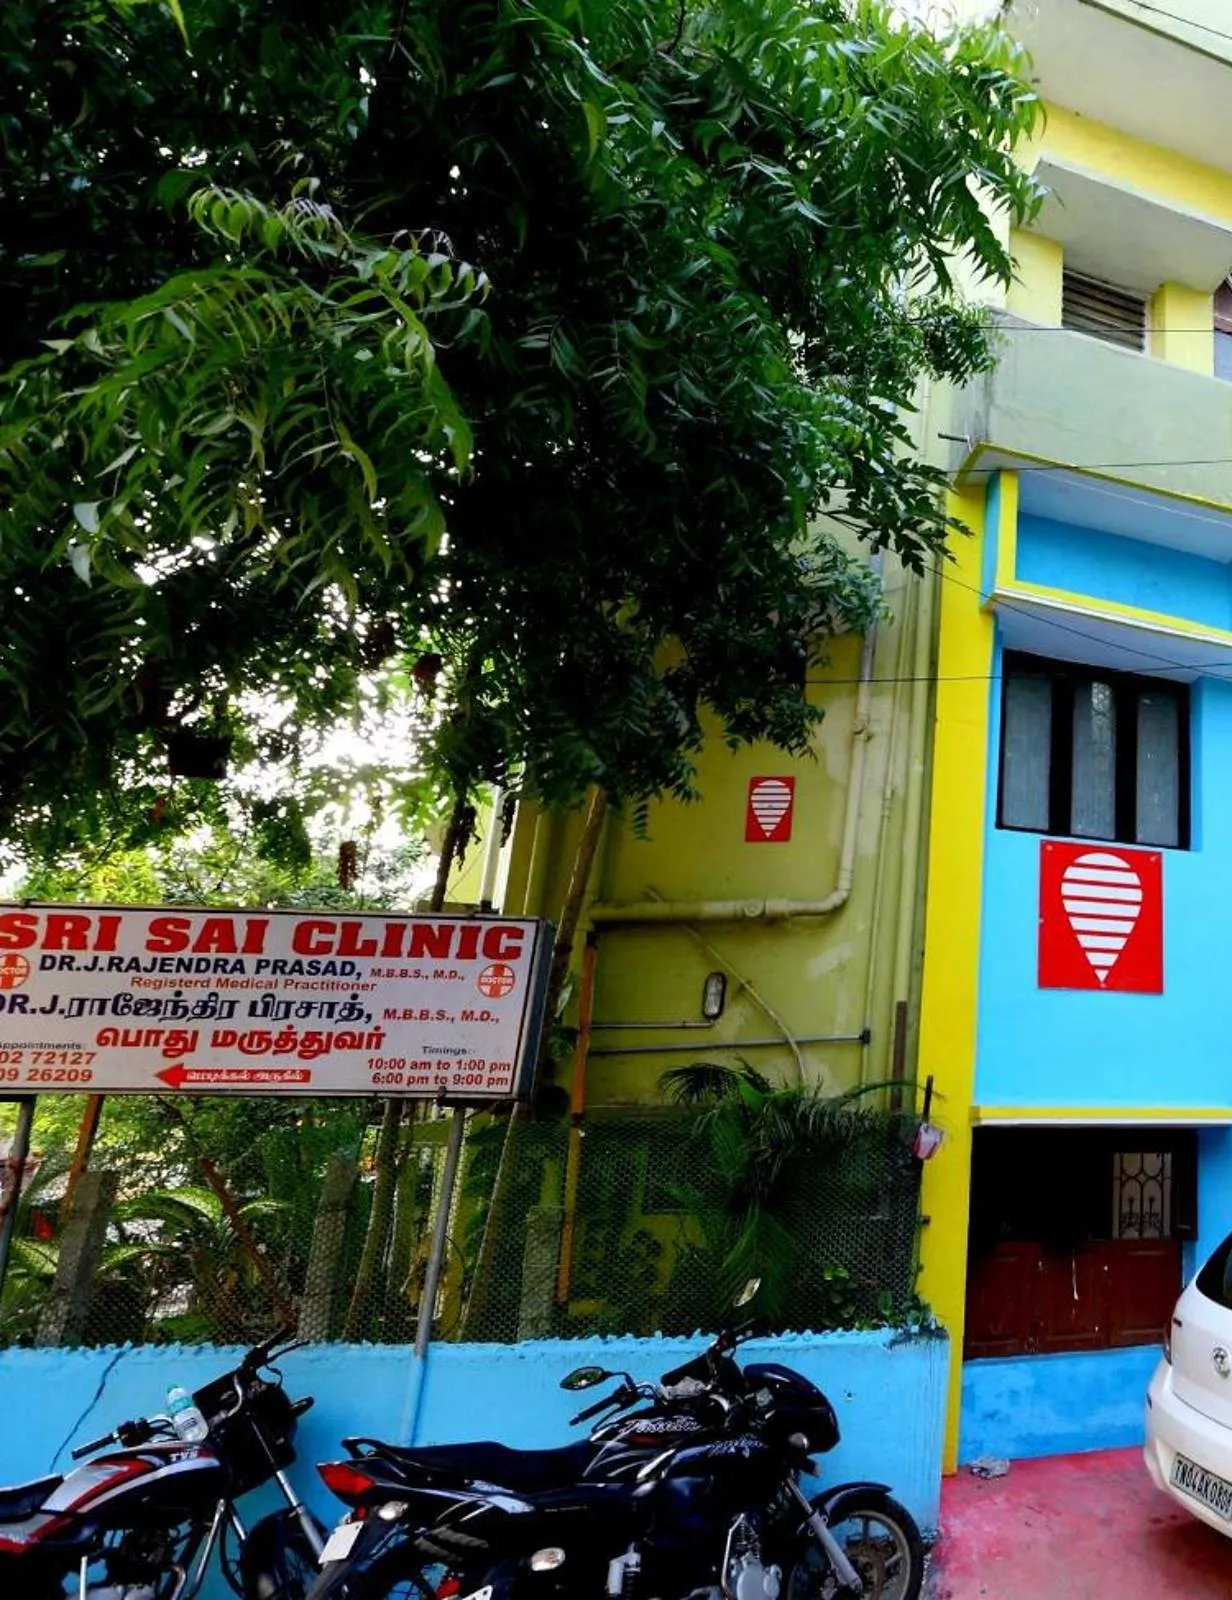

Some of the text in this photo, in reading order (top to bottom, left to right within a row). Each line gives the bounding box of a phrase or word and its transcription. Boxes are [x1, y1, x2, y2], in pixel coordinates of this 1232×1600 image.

[0, 913, 525, 960] SRI SAI CLINIC
[39, 954, 246, 974] DR.J.RAJENDRA
[254, 958, 362, 980] PRASAD,
[130, 976, 377, 992] Registerd Medical Practitioner
[0, 991, 240, 1022] R.J.ராஜேந்திர
[31, 1051, 97, 1065] 72127
[367, 1058, 511, 1074] 10:00 am to 1:00 pm
[26, 1068, 93, 1082] 26209
[372, 1072, 509, 1089] 6:00 pm to 9:00 pm
